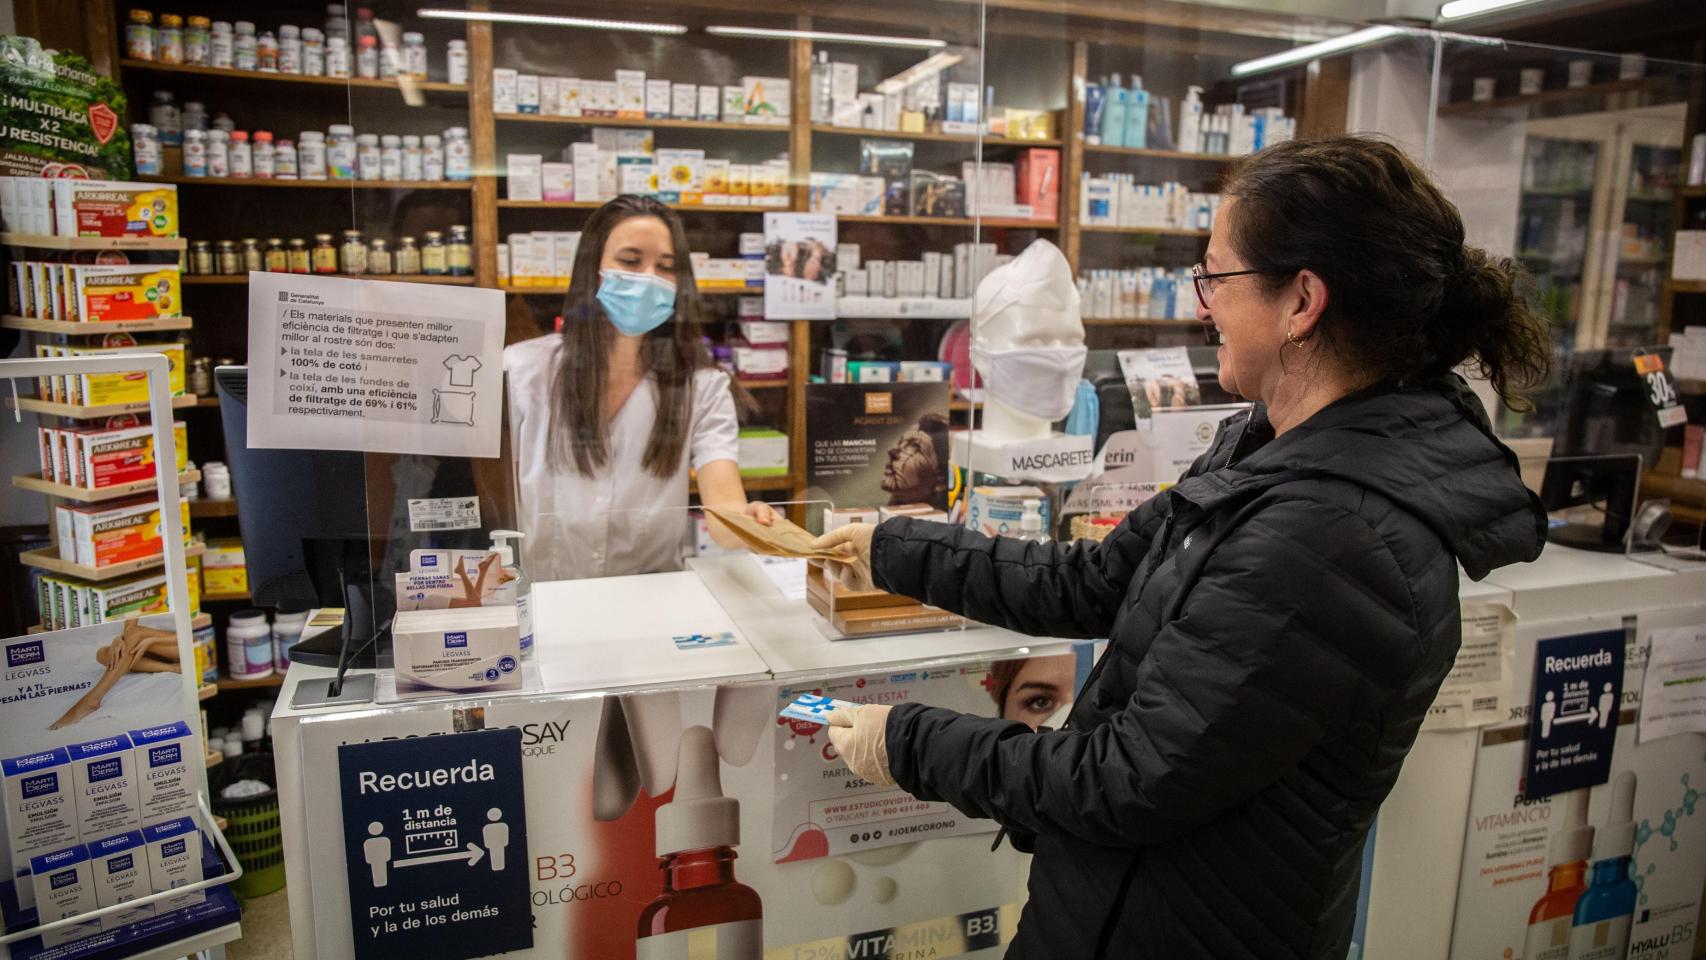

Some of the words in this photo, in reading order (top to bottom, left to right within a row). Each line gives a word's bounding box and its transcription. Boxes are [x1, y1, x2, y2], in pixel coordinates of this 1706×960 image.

[11, 96, 88, 125] MULTIPLICA
[290, 310, 305, 319] Els
[309, 311, 352, 323] materials
[355, 317, 373, 327] que
[376, 318, 423, 331] presenten
[427, 321, 452, 331] millor
[283, 321, 329, 332] eficiència
[333, 324, 344, 333] de
[348, 326, 382, 338] filtratge
[386, 329, 389, 337] i
[392, 331, 409, 341] que
[413, 331, 458, 344] s'adapten
[282, 333, 309, 342] millor
[313, 335, 321, 343] al
[324, 336, 352, 345] rostre
[355, 338, 372, 347] són
[375, 340, 395, 349] dos:
[291, 347, 300, 355] la
[303, 347, 323, 357] tela
[326, 350, 339, 358] de
[343, 350, 357, 359] les
[361, 353, 418, 365] samarretes
[291, 359, 318, 368] 100%
[323, 360, 335, 369] de
[339, 360, 361, 370] cotó
[290, 372, 300, 380] la
[303, 372, 322, 382] tela
[325, 374, 339, 383] de
[341, 375, 356, 384] les
[360, 376, 394, 387] fundes
[397, 379, 409, 389] de
[289, 383, 318, 394] coixí,
[321, 384, 343, 394] amb
[347, 387, 365, 395] una
[369, 387, 417, 400] eficiència
[289, 394, 302, 403] de
[305, 394, 346, 407] filtratge
[350, 397, 362, 407] de
[365, 399, 386, 408] 69%
[396, 401, 417, 411] 61%
[289, 405, 366, 417] respectivament.
[842, 438, 876, 446] MANCHAS
[1105, 448, 1134, 464] erin
[10, 645, 40, 654] MARTI
[11, 650, 40, 661] DERM
[442, 650, 470, 658] LEGVASS
[1545, 648, 1612, 674] Recuerda
[5, 666, 51, 680] LEGVASS
[0, 693, 26, 704] ESAN
[28, 690, 46, 700] LAS
[49, 682, 92, 695] PIERNAS?
[877, 690, 908, 703] ESTAT
[153, 748, 177, 756] MARTI
[153, 753, 178, 761] DERM
[1537, 750, 1549, 758] Por
[1551, 748, 1559, 756] tu
[1561, 743, 1581, 754] salud
[92, 762, 118, 770] MARTI
[1541, 762, 1548, 770] la
[1550, 760, 1559, 768] de
[1561, 758, 1571, 766] los
[1573, 753, 1597, 763] demás
[92, 767, 118, 776] DERM
[147, 766, 186, 780] LEGVASS
[359, 759, 495, 795] Recuerda
[823, 767, 852, 778] PARTI
[26, 777, 53, 786] MARTI
[26, 782, 55, 792] DERM
[86, 781, 128, 795] LEGVASS
[20, 796, 64, 812] LEGVASS
[824, 796, 914, 814] WWW.ESTUDICOVID19.
[403, 808, 409, 820] 1
[416, 808, 429, 818] m
[434, 805, 452, 816] de
[834, 812, 868, 822] TRUCANT
[404, 817, 457, 831] distancia
[1476, 810, 1527, 832] VITAMIN
[160, 855, 190, 868] LEGVASS
[537, 854, 576, 881] B3
[106, 871, 138, 884] LEGVASS
[50, 886, 83, 899] LEGVASS
[532, 880, 623, 906] OLÓGICO
[370, 905, 394, 918] Por
[400, 902, 415, 914] tu
[421, 894, 459, 910] salud
[370, 924, 379, 937] y
[385, 919, 398, 932] la
[402, 915, 420, 929] de
[425, 912, 447, 927] los
[452, 904, 499, 921] demás
[848, 926, 958, 960] VITAMINA
[1631, 934, 1670, 955] HYALU
[1672, 922, 1694, 944] B5
[895, 946, 937, 960] RINA
